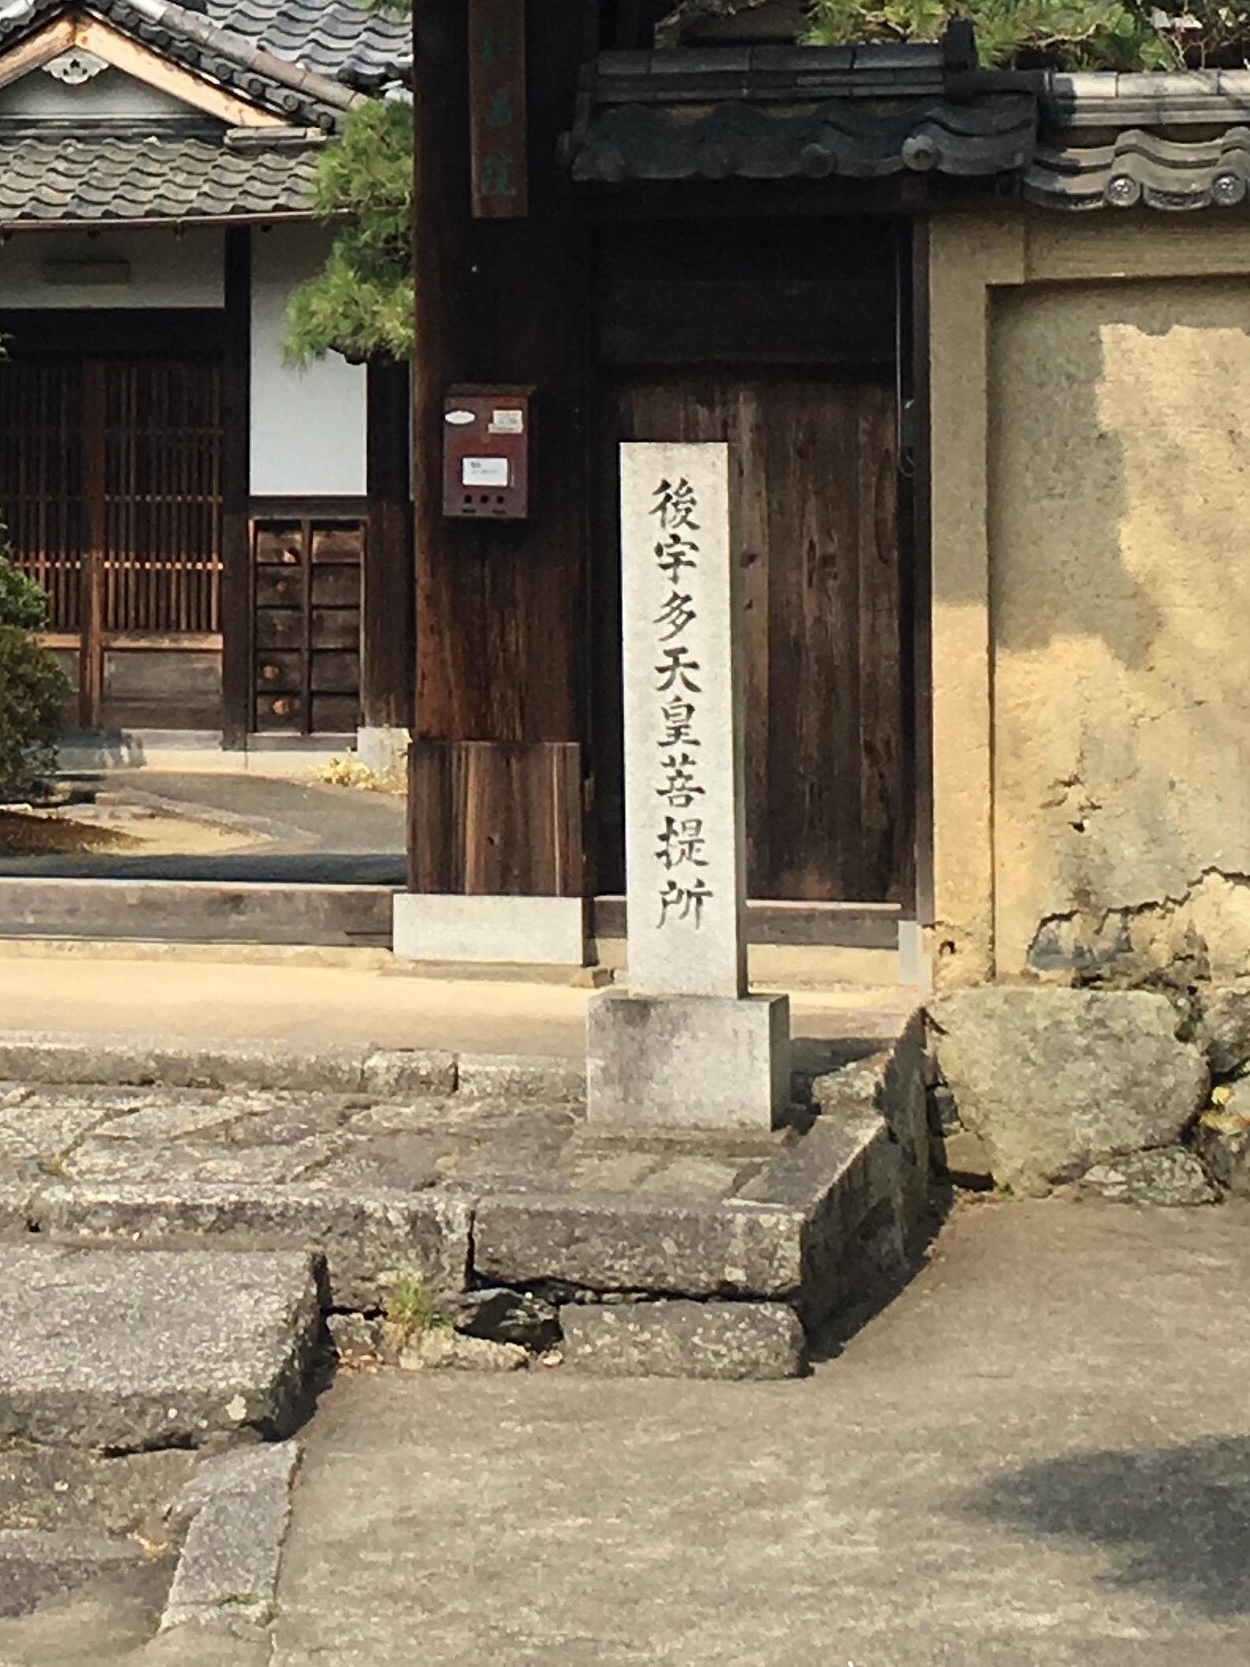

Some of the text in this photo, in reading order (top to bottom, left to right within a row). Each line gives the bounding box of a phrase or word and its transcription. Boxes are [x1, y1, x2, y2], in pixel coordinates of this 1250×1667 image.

[648, 477, 713, 930] 後宇多天皇菩提所
